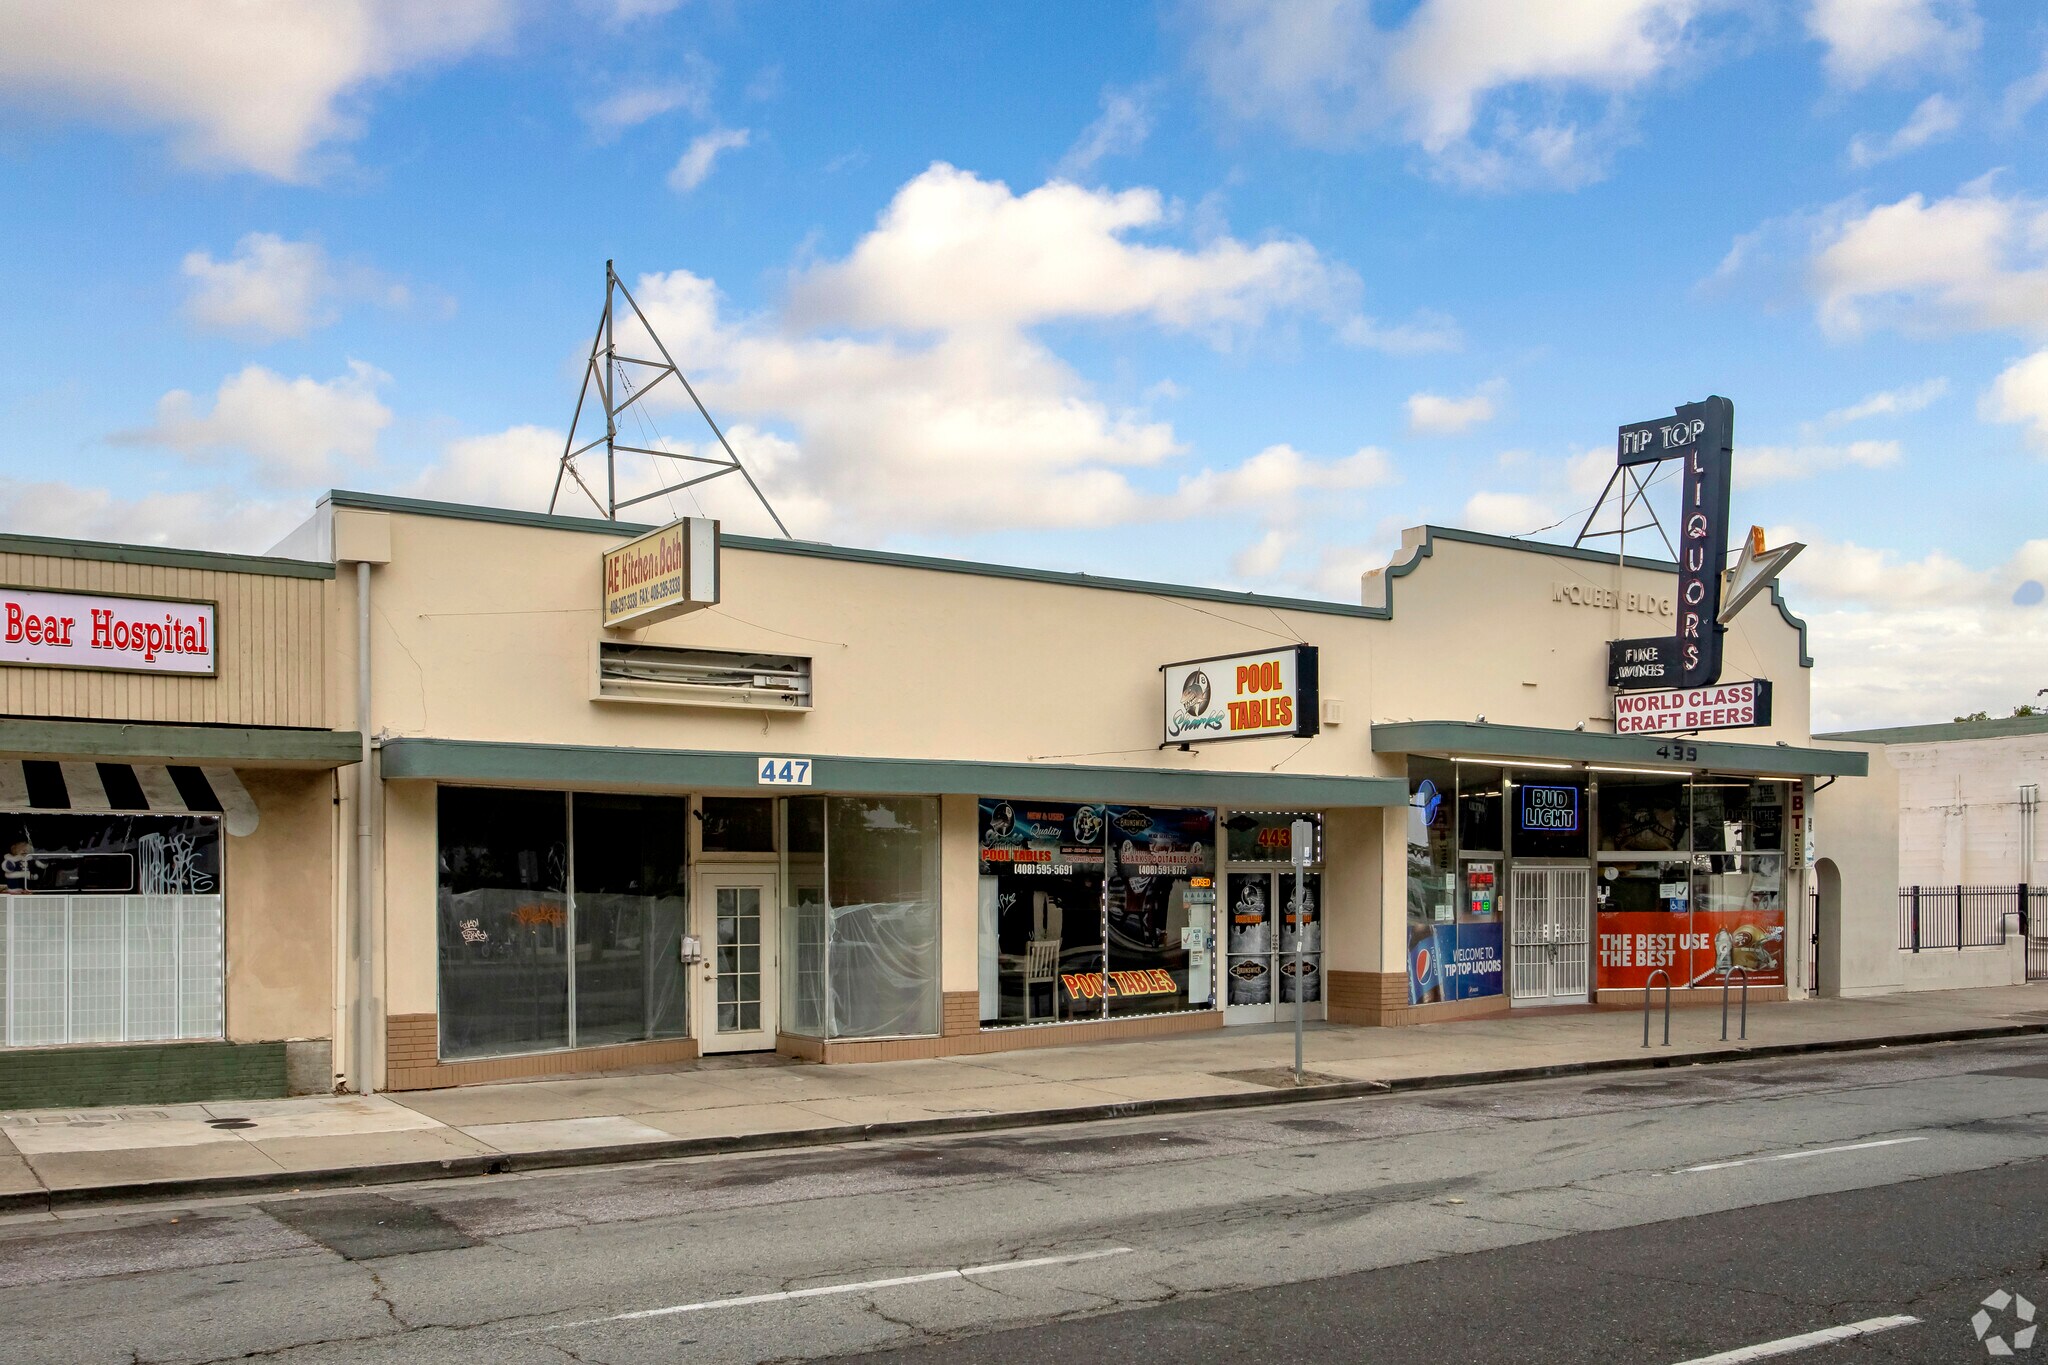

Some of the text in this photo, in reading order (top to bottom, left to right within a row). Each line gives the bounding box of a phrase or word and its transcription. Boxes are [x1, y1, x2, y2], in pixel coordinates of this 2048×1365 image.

[1621, 419, 1705, 455] TIP TOP
[607, 556, 619, 595] AE
[622, 547, 654, 590] Kitchen
[660, 531, 682, 576] Bath
[1683, 448, 1707, 672] LIQUORS
[5, 602, 210, 663] Bear Hospital
[1625, 647, 1659, 663] FINE
[1236, 660, 1283, 695] POOL
[1618, 664, 1665, 678] WINES
[1617, 686, 1753, 713] WORLD CLASS
[1227, 695, 1293, 731] TABLES
[1617, 706, 1753, 732] CRAFT BEERS
[1168, 709, 1226, 738] Sharks
[1656, 745, 1698, 762] 439
[761, 760, 810, 783] 447
[1532, 789, 1568, 808] BUD
[1027, 812, 1041, 820] NEW
[1048, 813, 1065, 821] USED
[1525, 807, 1574, 827] LIGHT
[1030, 823, 1062, 839] Quality
[1258, 828, 1291, 847] 443
[982, 849, 1010, 861] POOL
[1013, 850, 1052, 862] TABLES
[1014, 864, 1073, 875] (408) 595-5691
[1138, 865, 1187, 875] (408) 591-8775
[1600, 933, 1710, 950] THE BEST USE
[1452, 946, 1494, 962] WELCOME TO
[1600, 950, 1676, 967] THE BEST
[1445, 960, 1502, 977] TIP TOP LIQUORS
[1061, 969, 1178, 999] POOL TABLES
